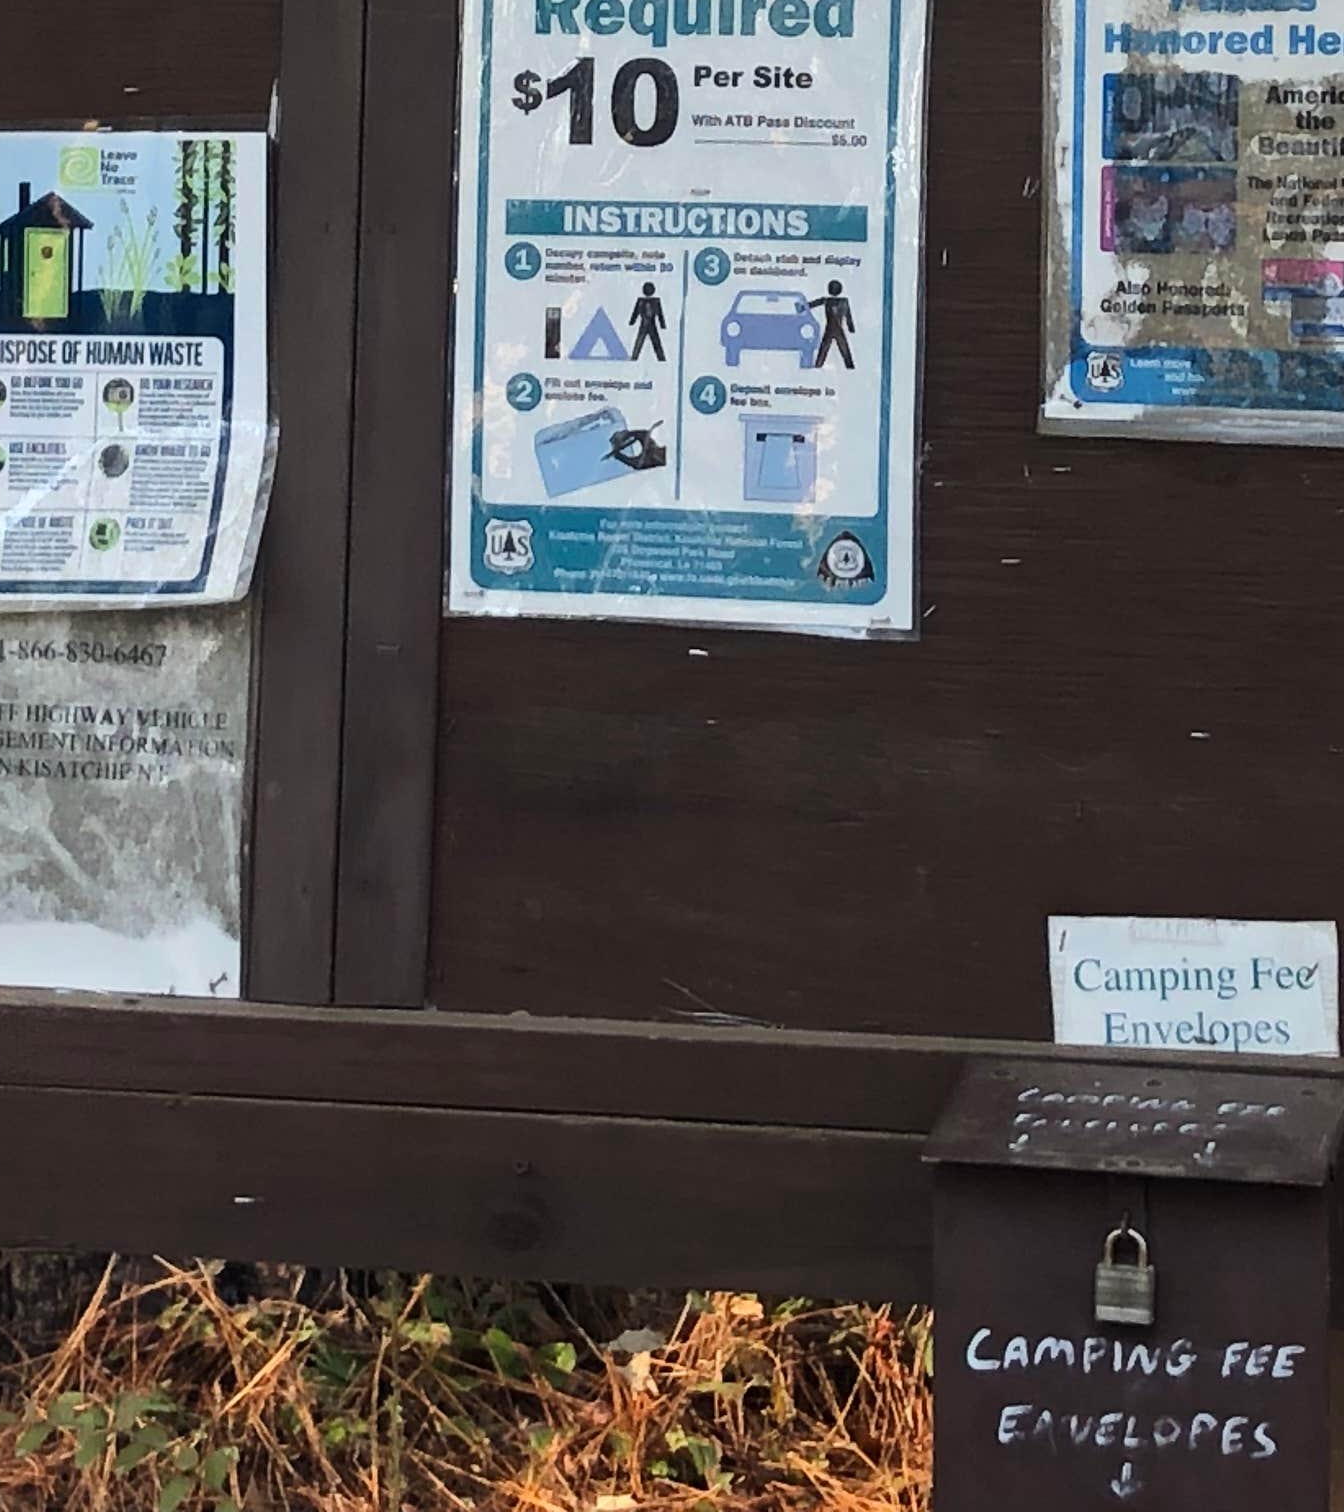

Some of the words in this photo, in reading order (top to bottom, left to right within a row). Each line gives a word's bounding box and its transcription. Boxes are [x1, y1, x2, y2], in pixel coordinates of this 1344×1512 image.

[1103, 22, 1275, 56] Honored
[511, 56, 680, 148] $10
[694, 66, 744, 88] Per
[752, 66, 813, 89] Site
[692, 114, 722, 128] With
[758, 116, 790, 128] Pass
[794, 116, 855, 130] Discount
[1296, 109, 1336, 130] the
[100, 149, 137, 160] Leave
[100, 161, 119, 173] No
[101, 173, 135, 185] Trace
[1247, 175, 1273, 189] The
[563, 205, 809, 238] INSTRUCTIONS
[515, 249, 532, 271] 1
[704, 254, 720, 277] 3
[1115, 280, 1151, 295] Also
[1100, 298, 1157, 314] Golden
[1162, 300, 1246, 318] Passports
[62, 341, 82, 364] OF
[86, 341, 144, 365] HUMAN
[149, 342, 203, 366] WASTE
[516, 381, 533, 403] 2
[699, 384, 717, 406] 4
[26, 704, 130, 726] HIGHWAY
[137, 708, 229, 730] VEHICLE
[85, 734, 236, 759] INFORMATION
[1073, 957, 1238, 1001] Camping
[1251, 957, 1316, 990] Fee
[1104, 1011, 1291, 1053] Envelopes
[966, 1327, 1197, 1377] CAMPING
[1221, 1342, 1306, 1378] FEE
